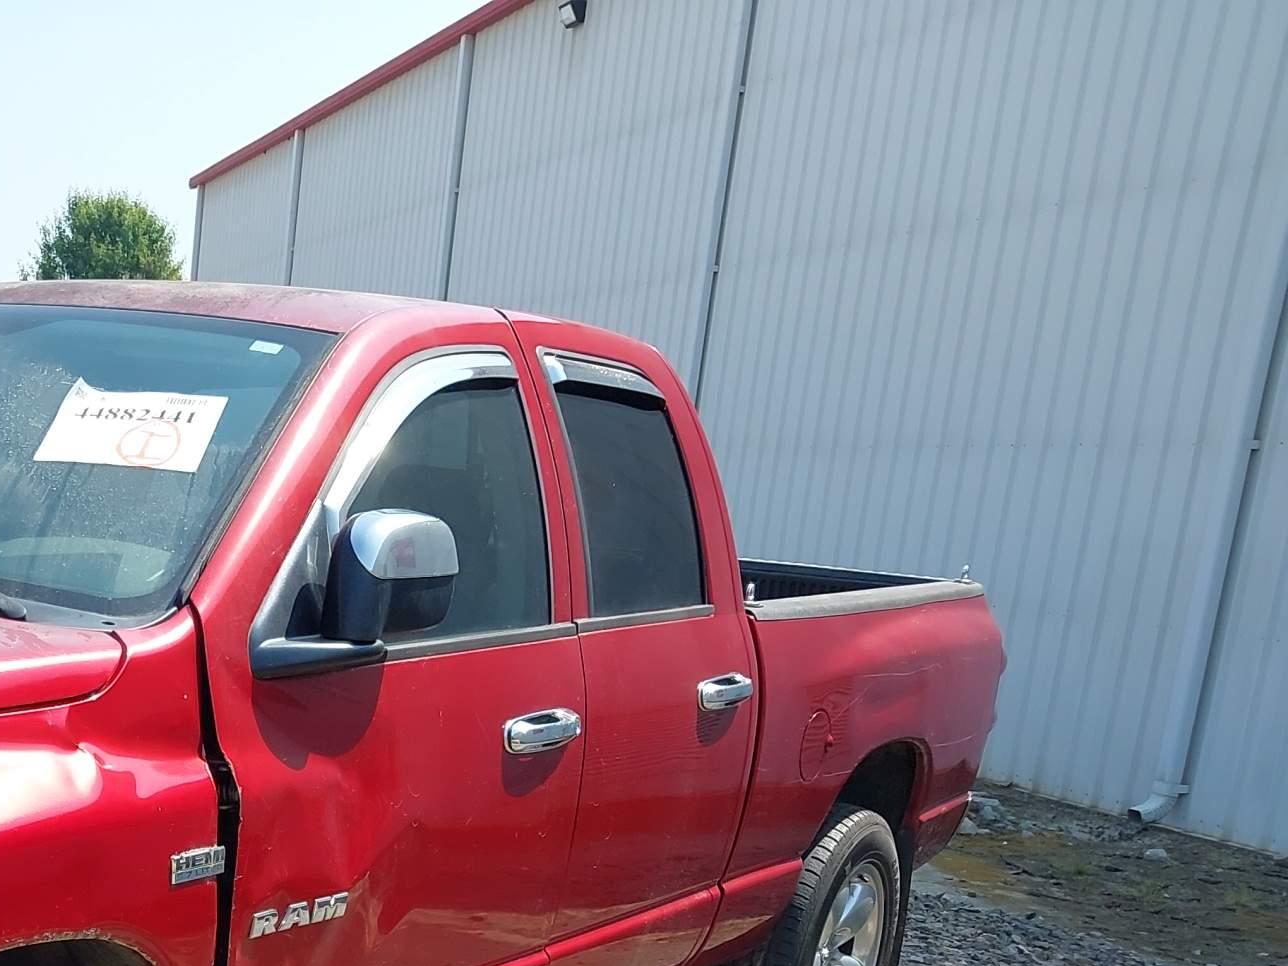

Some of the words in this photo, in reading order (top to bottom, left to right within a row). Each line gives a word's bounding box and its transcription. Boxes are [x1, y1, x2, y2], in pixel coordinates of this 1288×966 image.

[73, 406, 197, 424] 44882441
[174, 848, 225, 872] HEMI
[248, 891, 349, 940] RAM
